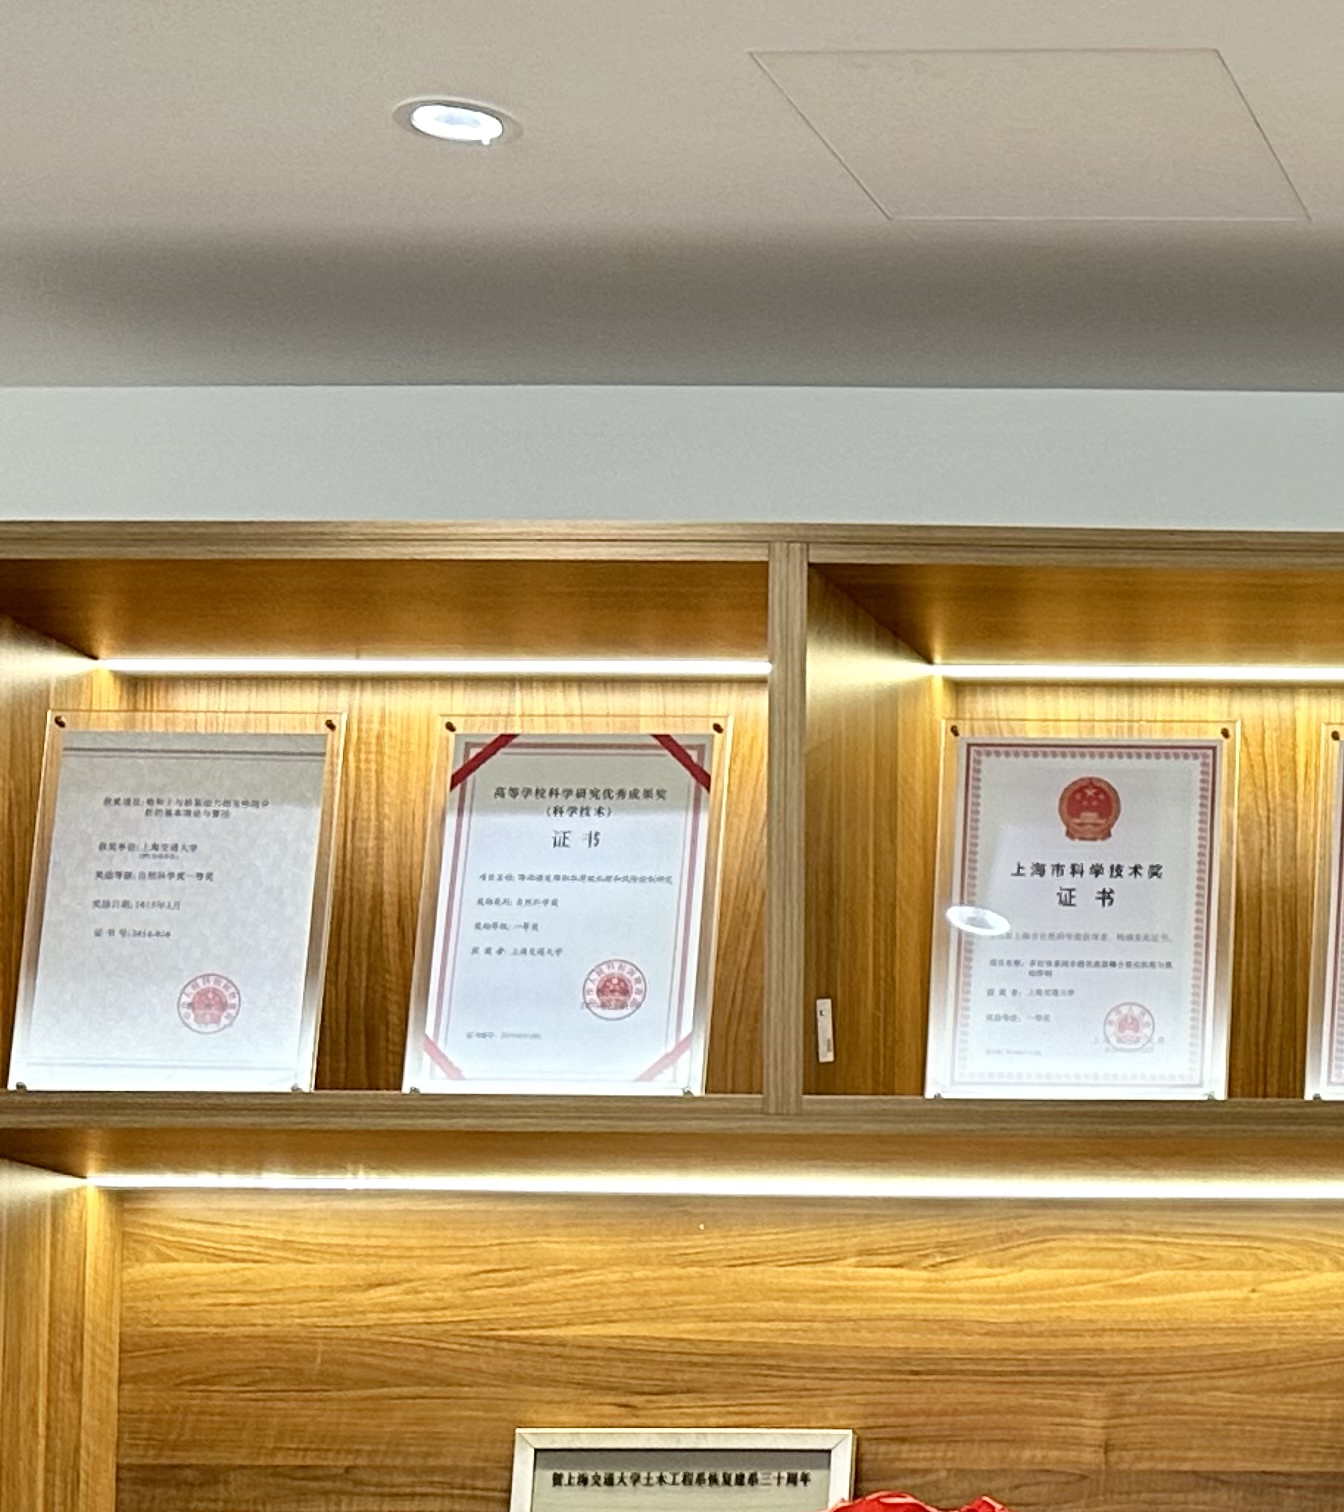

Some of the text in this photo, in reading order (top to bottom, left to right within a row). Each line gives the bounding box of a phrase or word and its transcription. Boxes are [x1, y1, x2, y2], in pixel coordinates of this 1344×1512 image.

[493, 787, 667, 800] 高等学校科学研究优秀成果奖
[552, 830, 600, 848] 证书
[1011, 862, 1164, 879] 上海市科学技术奖
[1056, 886, 1115, 908] 证书
